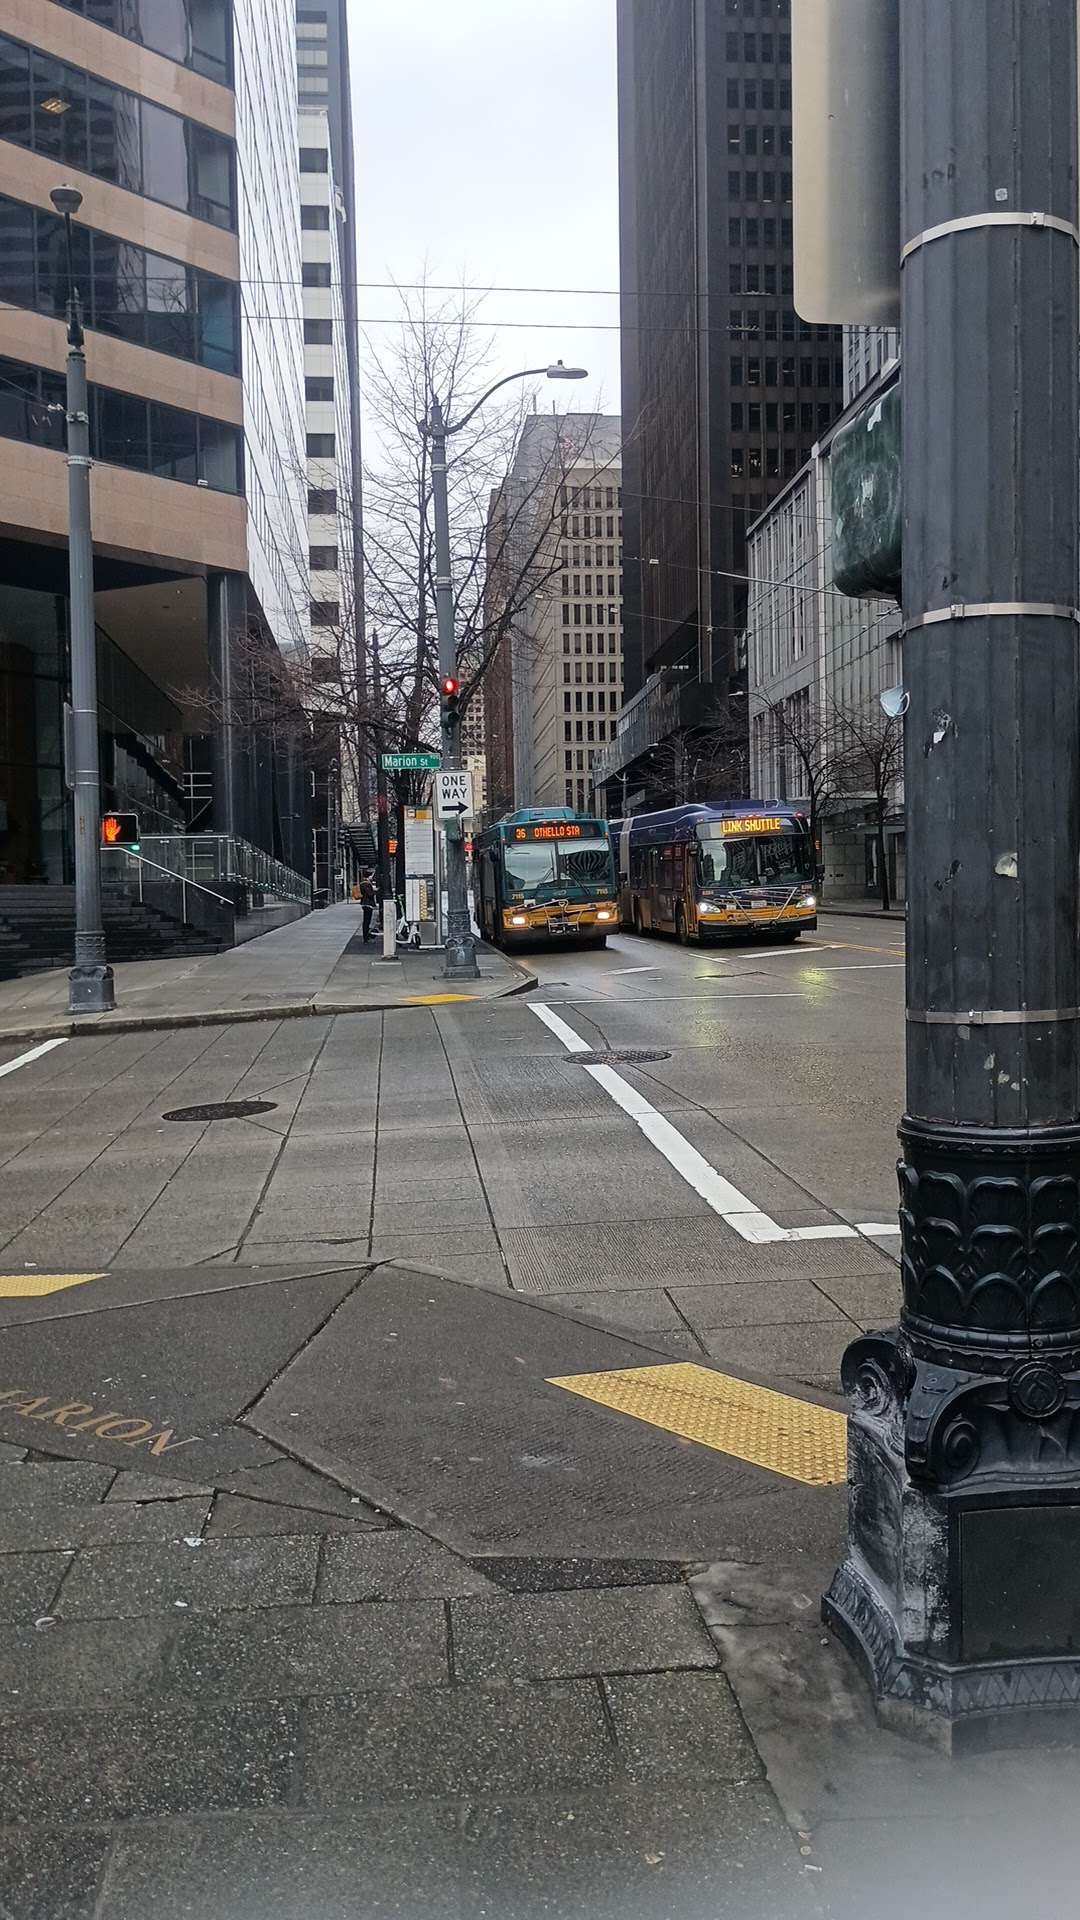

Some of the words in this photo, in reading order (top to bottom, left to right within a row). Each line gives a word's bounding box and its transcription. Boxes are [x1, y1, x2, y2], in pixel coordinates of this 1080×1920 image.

[384, 756, 417, 767] Marion
[420, 758, 428, 766] St
[442, 776, 466, 786] ONE
[442, 788, 467, 799] WAY
[722, 820, 742, 833] LINK
[744, 818, 780, 831] SHUTTLE
[516, 828, 526, 839] 36
[534, 827, 564, 838] OTHELLO
[566, 825, 580, 836] STA
[0, 1390, 203, 1456] ARION
